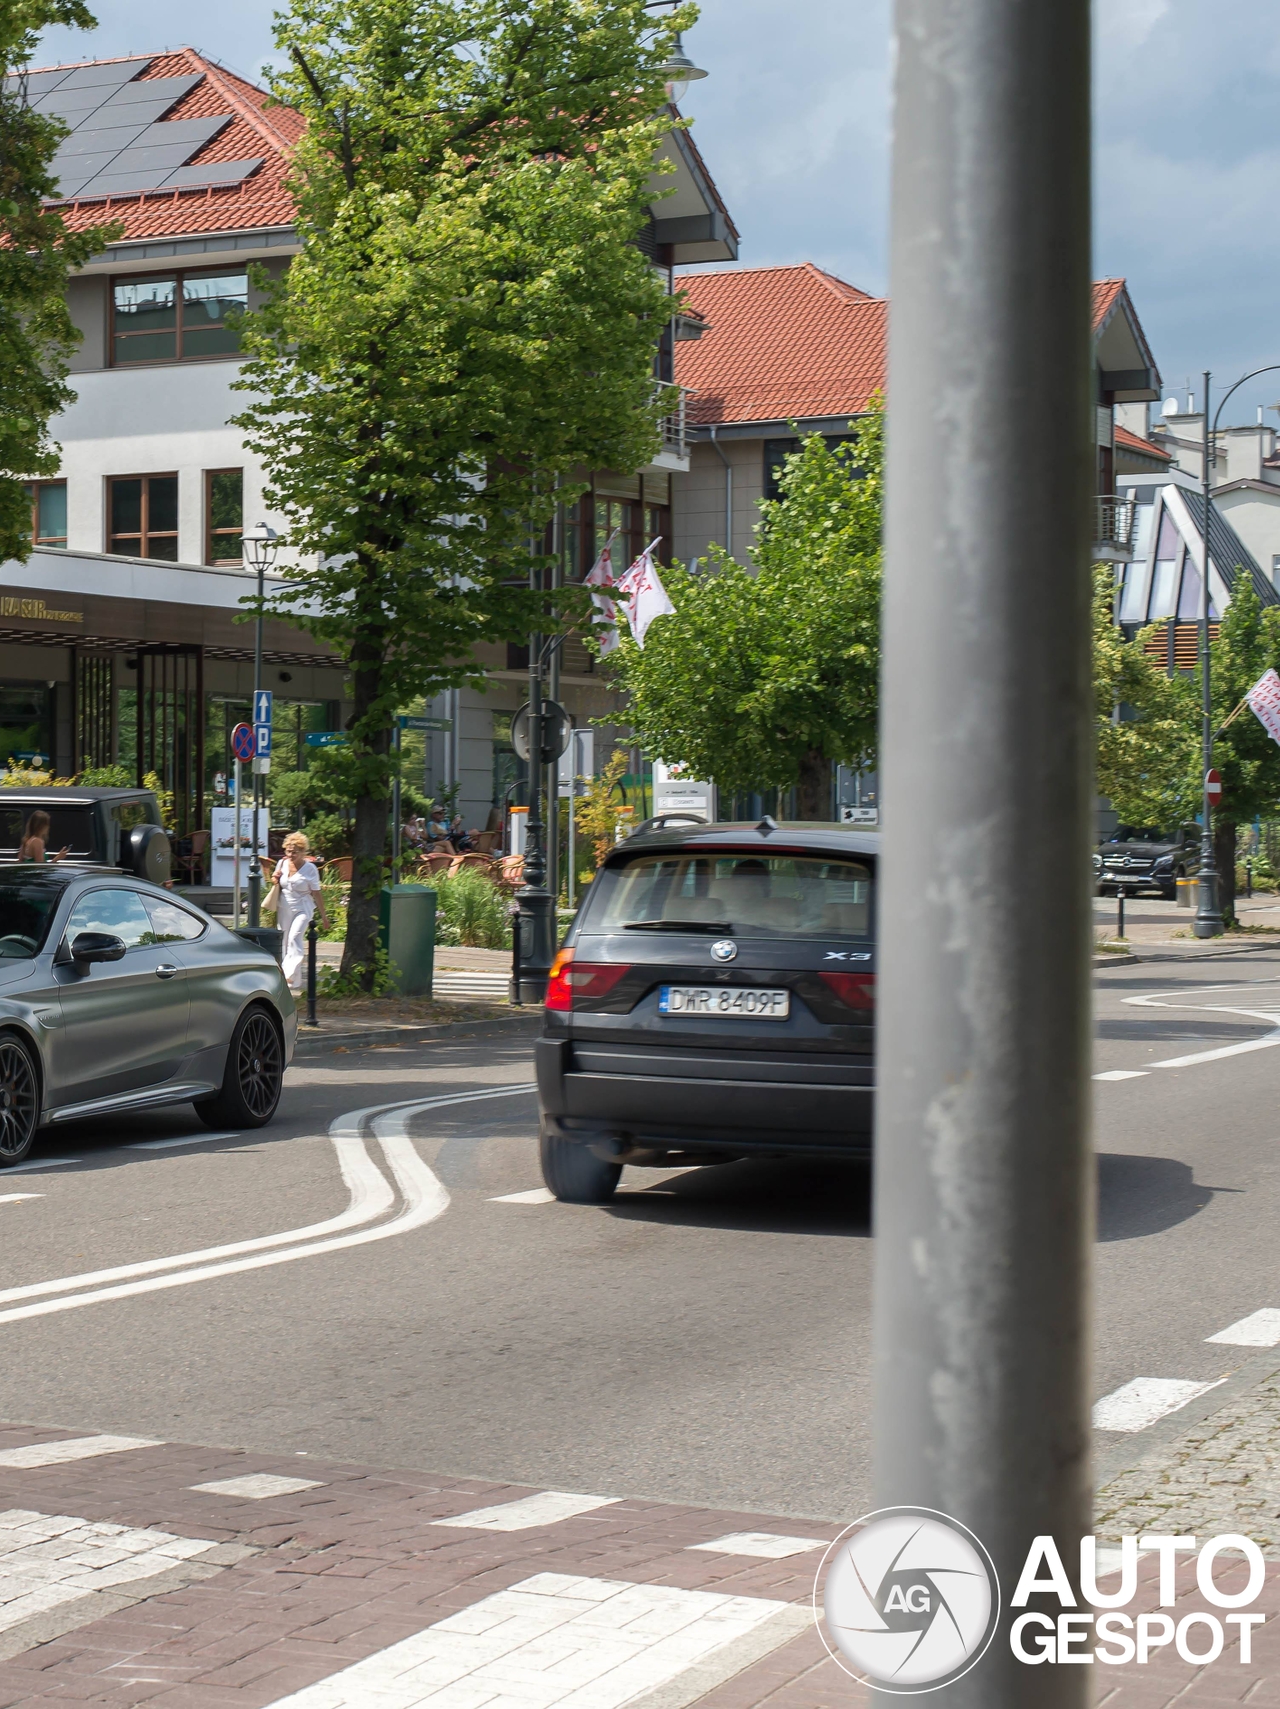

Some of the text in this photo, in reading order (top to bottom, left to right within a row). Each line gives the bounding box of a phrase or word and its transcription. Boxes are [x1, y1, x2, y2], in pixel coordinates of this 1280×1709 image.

[257, 727, 269, 754] P
[822, 951, 872, 961] X3
[671, 989, 785, 1014] DWR 8409F
